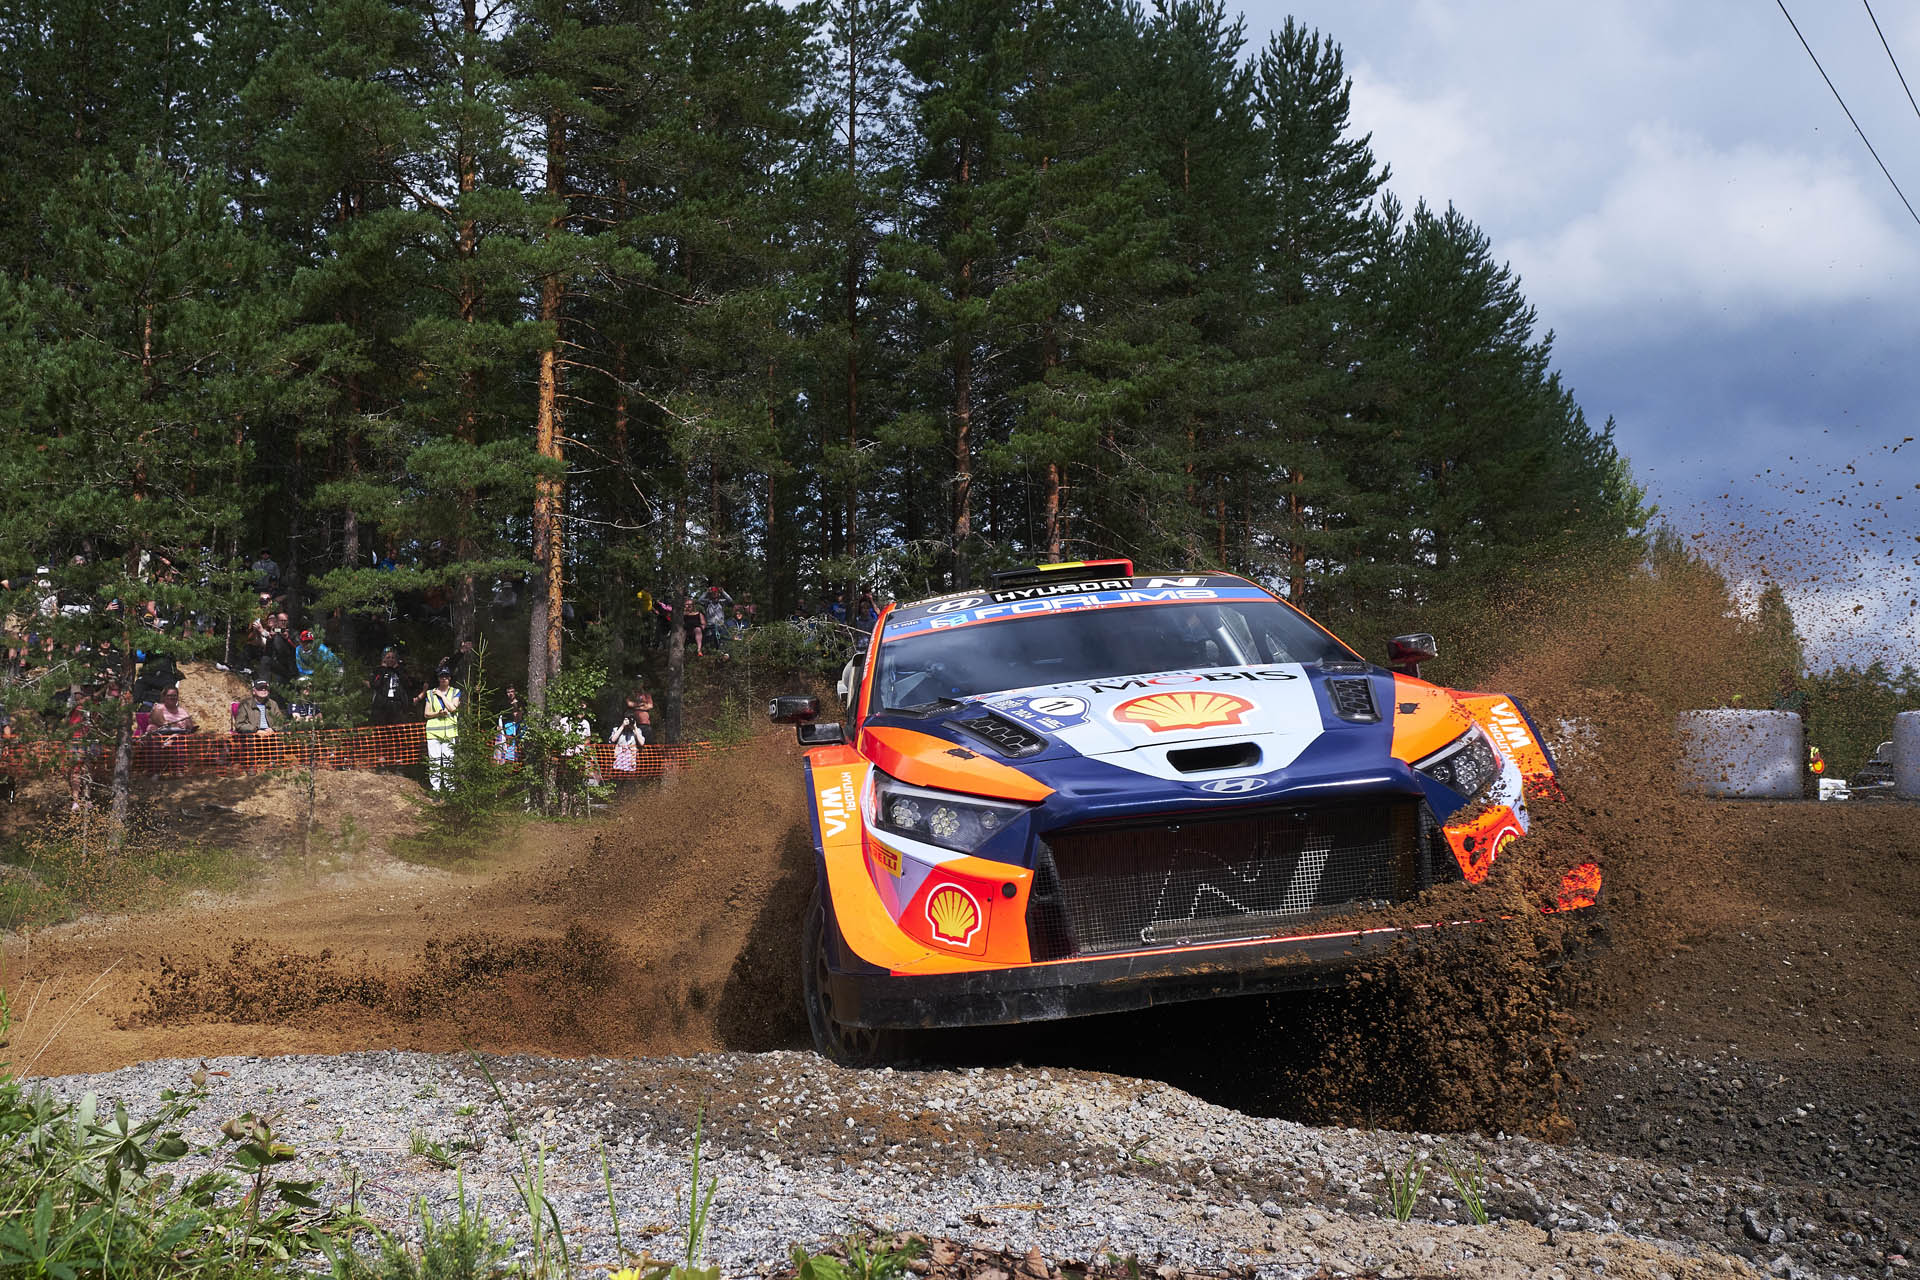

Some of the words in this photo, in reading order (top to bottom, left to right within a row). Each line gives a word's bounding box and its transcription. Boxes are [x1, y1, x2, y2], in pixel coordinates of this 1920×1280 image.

[974, 588, 1219, 620] FORUM8
[1088, 670, 1298, 694] MOBIS
[1039, 701, 1074, 712] 11
[840, 771, 857, 811] HYUNDAI
